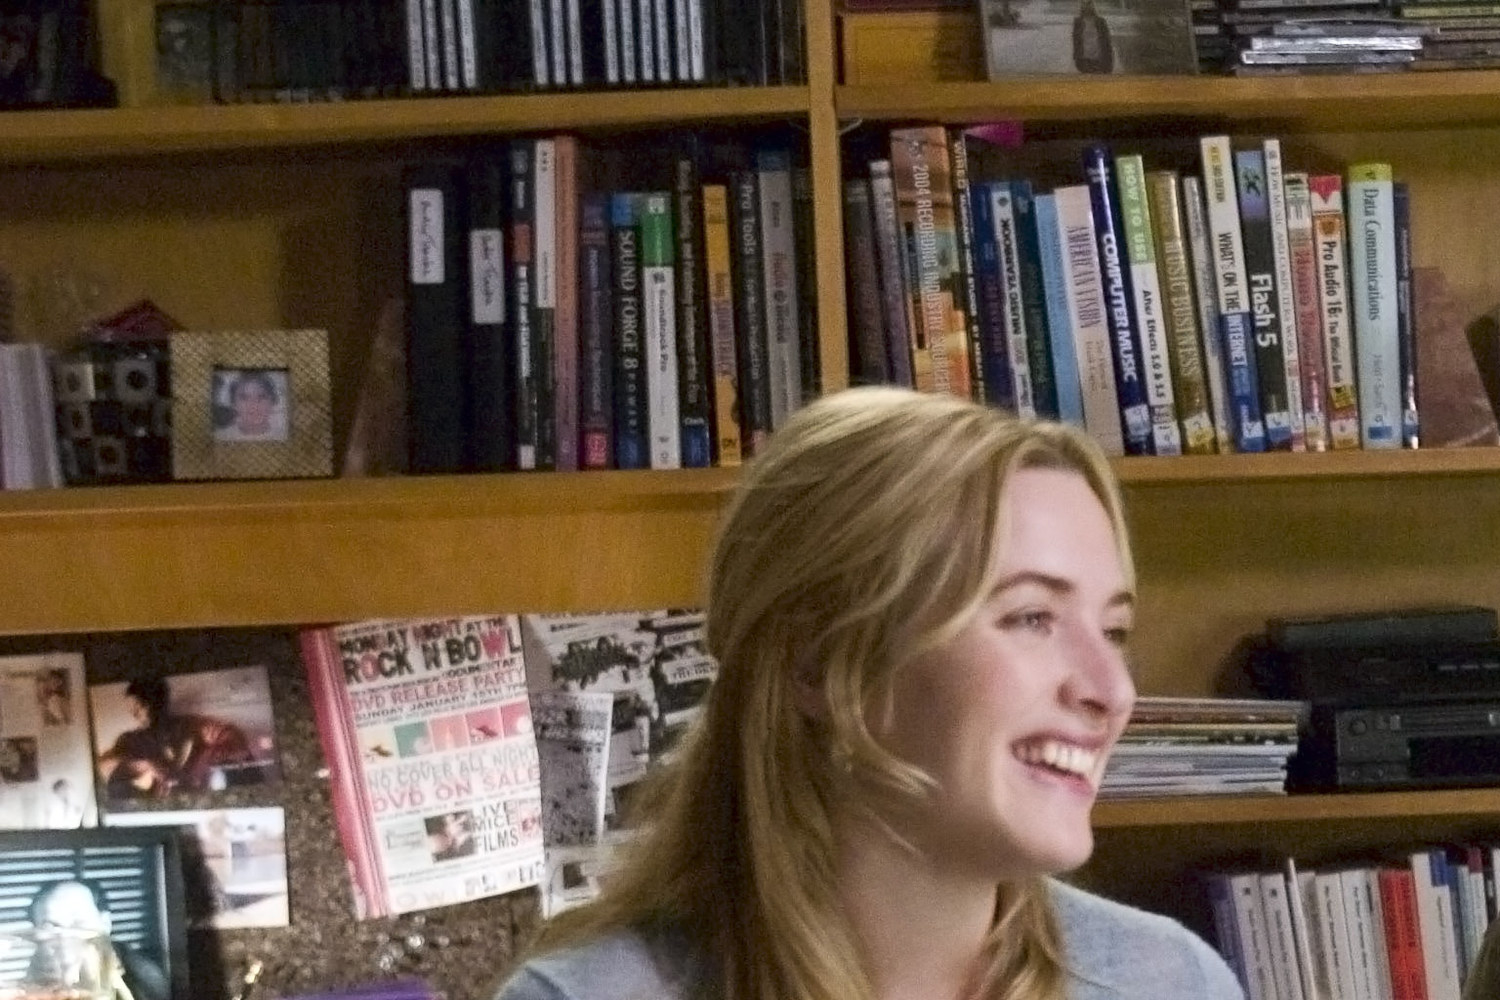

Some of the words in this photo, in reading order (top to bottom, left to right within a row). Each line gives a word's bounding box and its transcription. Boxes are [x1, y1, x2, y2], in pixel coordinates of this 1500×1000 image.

[742, 185, 753, 209] Pro
[912, 165, 930, 196] 2004
[1124, 164, 1139, 200] HOW
[1131, 209, 1142, 226] TO
[1364, 188, 1380, 216] Data
[743, 218, 756, 254] Tools
[917, 200, 938, 267] RECORDING
[1323, 241, 1337, 260] Pro
[620, 230, 636, 290] SOUND
[1001, 218, 1020, 289] YEARBOOK
[1165, 241, 1190, 292] MUSIC
[1365, 220, 1383, 320] Communications
[1103, 234, 1133, 327] COMPUTER
[1223, 272, 1238, 287] ON
[1325, 264, 1342, 297] Audio
[923, 272, 945, 330] INDUSTRY
[1010, 292, 1023, 335] MUSIC
[1143, 291, 1152, 315] After
[1225, 292, 1242, 311] THE
[1251, 274, 1276, 326] Flash
[622, 297, 638, 353] FORGE
[1147, 320, 1159, 351] Effects
[1171, 296, 1200, 377] BUSINESS
[1227, 314, 1248, 366] INTERNET
[1256, 332, 1278, 347] 5
[623, 358, 639, 369] 8
[660, 354, 669, 372] Pro
[1117, 331, 1136, 382] MUSIC
[340, 627, 408, 654] MONDAY
[343, 645, 414, 686] ROCK
[445, 627, 522, 666] BOWL
[351, 693, 386, 713] DVD
[391, 677, 468, 705] RELEASE
[473, 667, 526, 689] PARTY
[354, 704, 404, 721] SUNDAY
[409, 693, 468, 712] JANUARY
[396, 762, 454, 786] COVER
[459, 756, 485, 776] ALL
[491, 744, 537, 766] NIGHT
[372, 787, 425, 813] DVD
[435, 778, 473, 801] ON
[483, 766, 541, 791] SALE
[476, 828, 520, 853] FILMS
